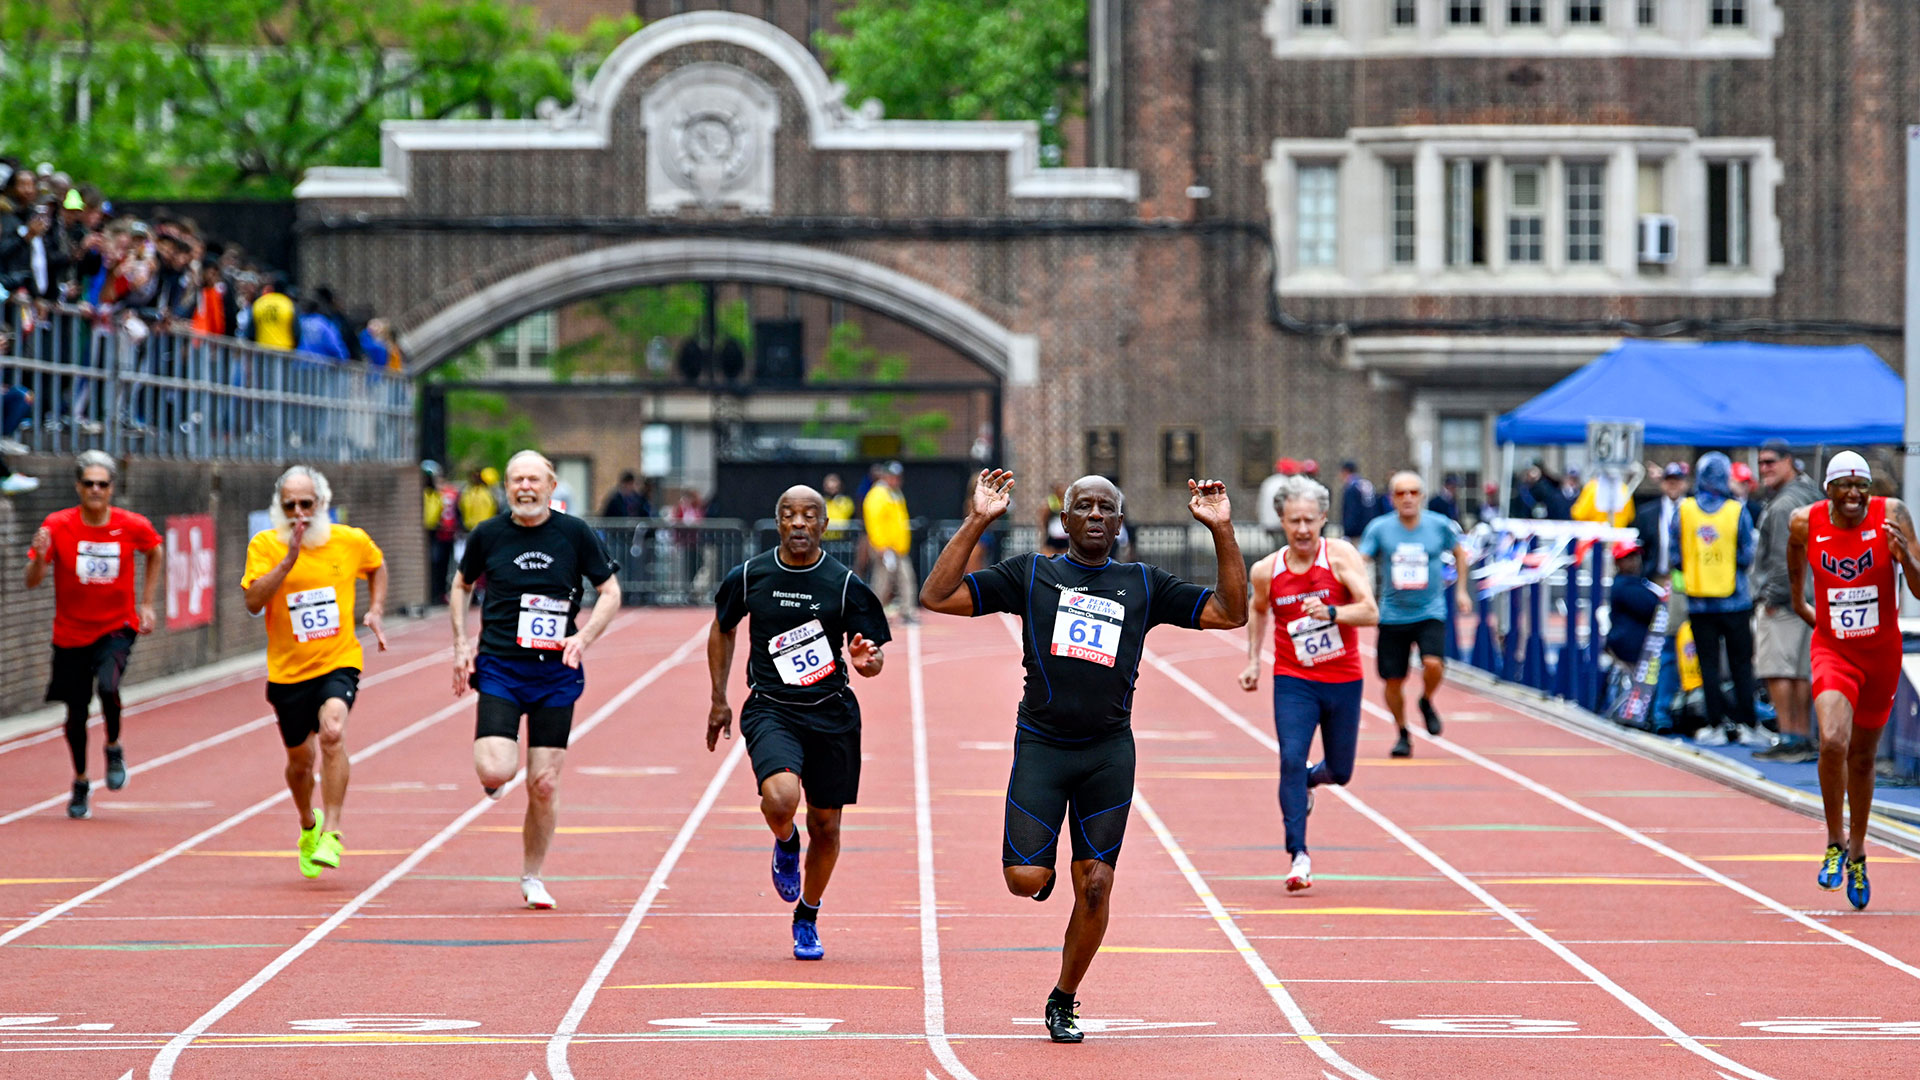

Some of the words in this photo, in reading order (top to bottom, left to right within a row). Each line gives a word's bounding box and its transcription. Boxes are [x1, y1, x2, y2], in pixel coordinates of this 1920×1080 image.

[1821, 547, 1873, 582] USA
[772, 590, 812, 600] Houston
[780, 600, 801, 608] Elite
[1088, 598, 1111, 608] PENN
[301, 608, 328, 629] 65
[1086, 604, 1117, 615] RELAYS
[1840, 608, 1868, 628] 67
[308, 629, 336, 639] TOYOTA
[531, 617, 557, 637] 63
[789, 626, 808, 638] PENN
[1069, 619, 1103, 649] 61
[1845, 628, 1876, 638] TOYOTA
[1305, 633, 1332, 654] 64
[792, 649, 819, 673] 56
[1070, 647, 1109, 664] TOYOTA
[801, 664, 834, 685] TOYOTA
